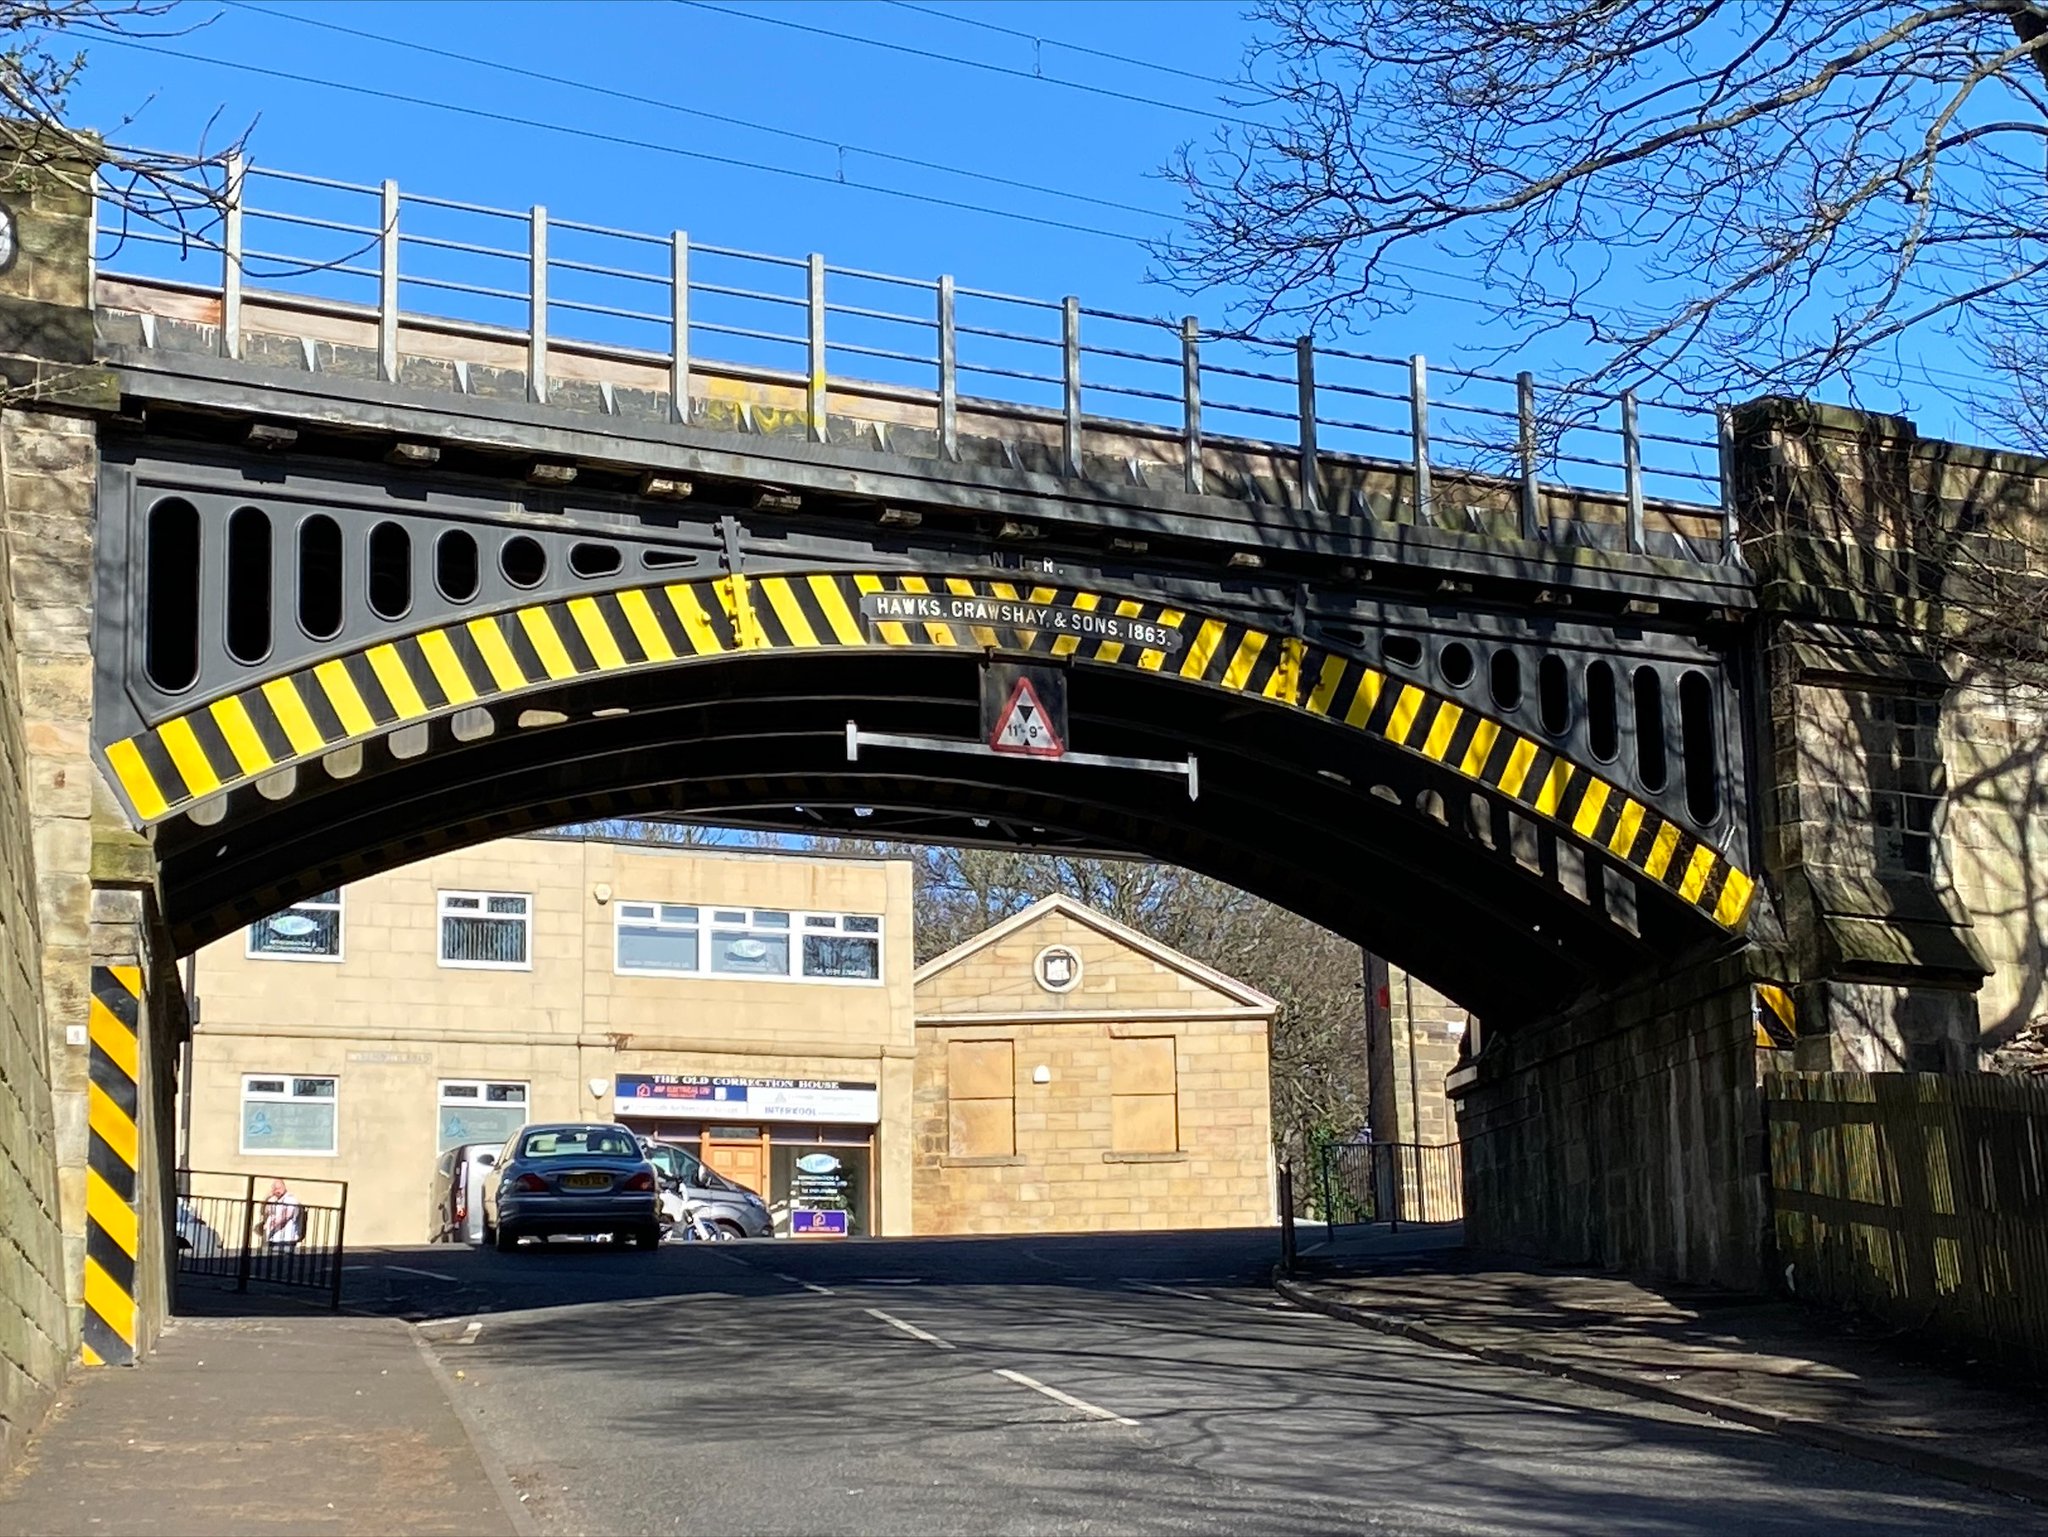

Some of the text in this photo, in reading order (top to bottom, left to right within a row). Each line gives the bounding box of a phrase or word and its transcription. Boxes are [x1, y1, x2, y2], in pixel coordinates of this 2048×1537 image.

[1054, 611, 1067, 628] &
[652, 1075, 840, 1090] THE OLD CORRECTION HOUSE
[764, 1106, 817, 1116] INTERKOOL
